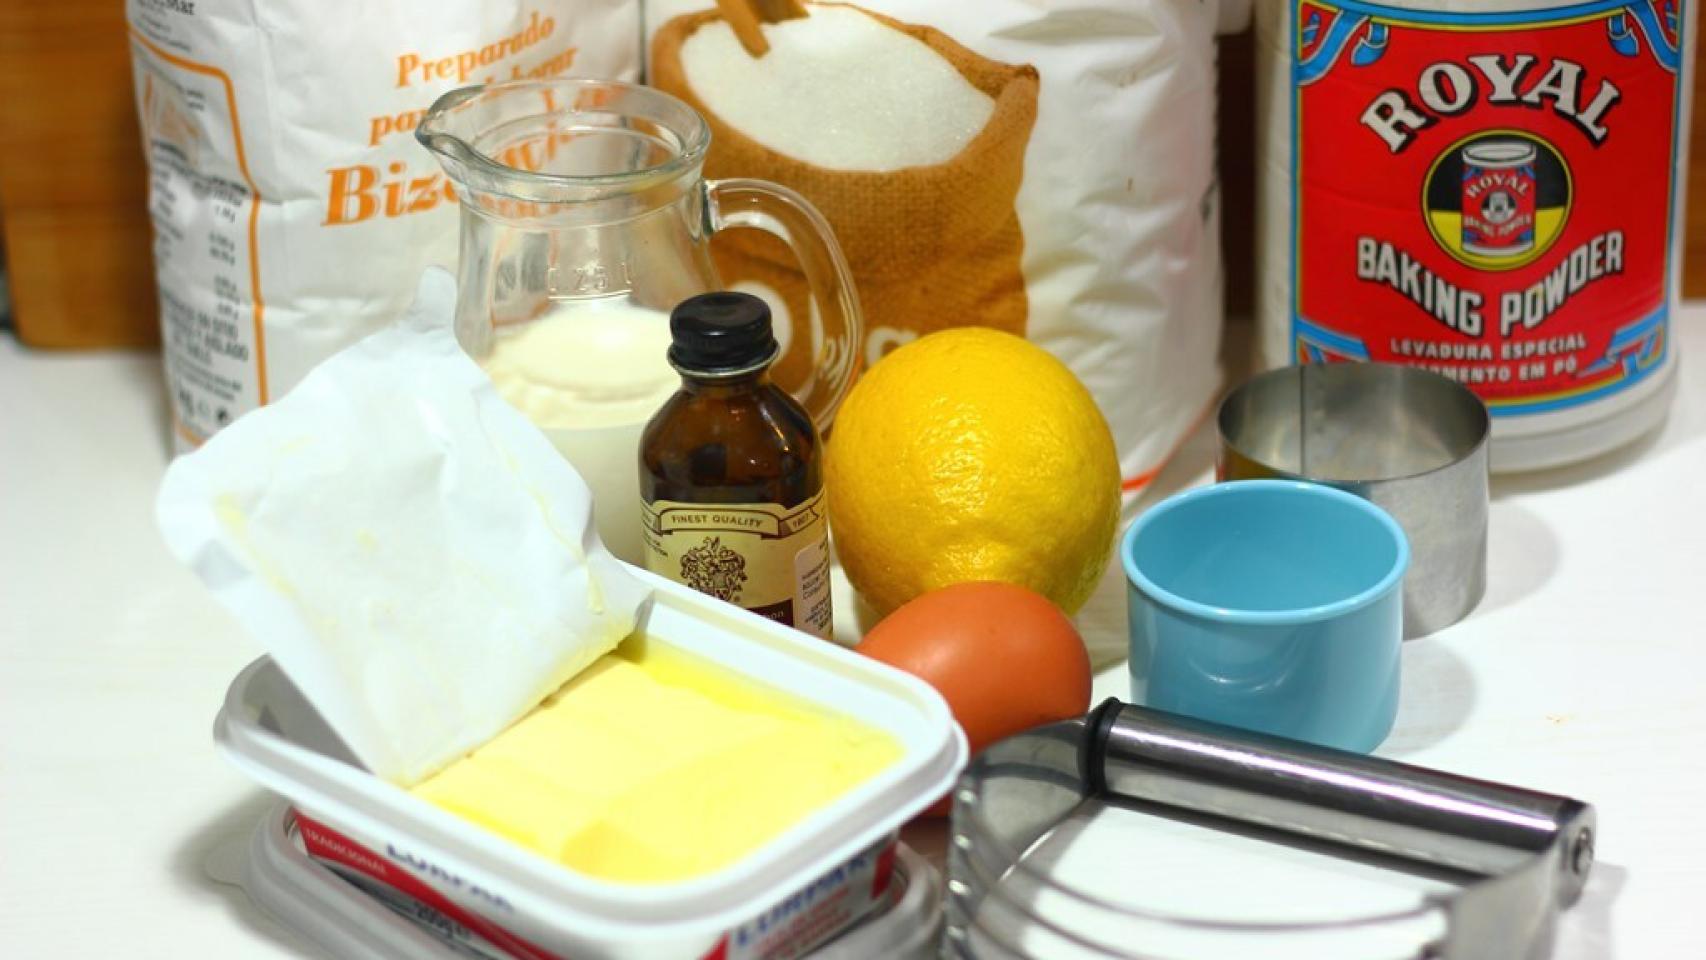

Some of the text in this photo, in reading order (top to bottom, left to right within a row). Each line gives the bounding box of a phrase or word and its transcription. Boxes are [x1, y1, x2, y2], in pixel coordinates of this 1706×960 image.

[394, 11, 555, 90] Preparado
[1359, 53, 1622, 153] ROYAL
[1465, 173, 1529, 198] ROYAL
[1356, 230, 1625, 338] BAKING POWDER
[1390, 332, 1587, 360] LEVADURA ESPECIAL
[1408, 354, 1578, 383] MENTO EM PÓ
[671, 514, 762, 528] FINEST QUALITY
